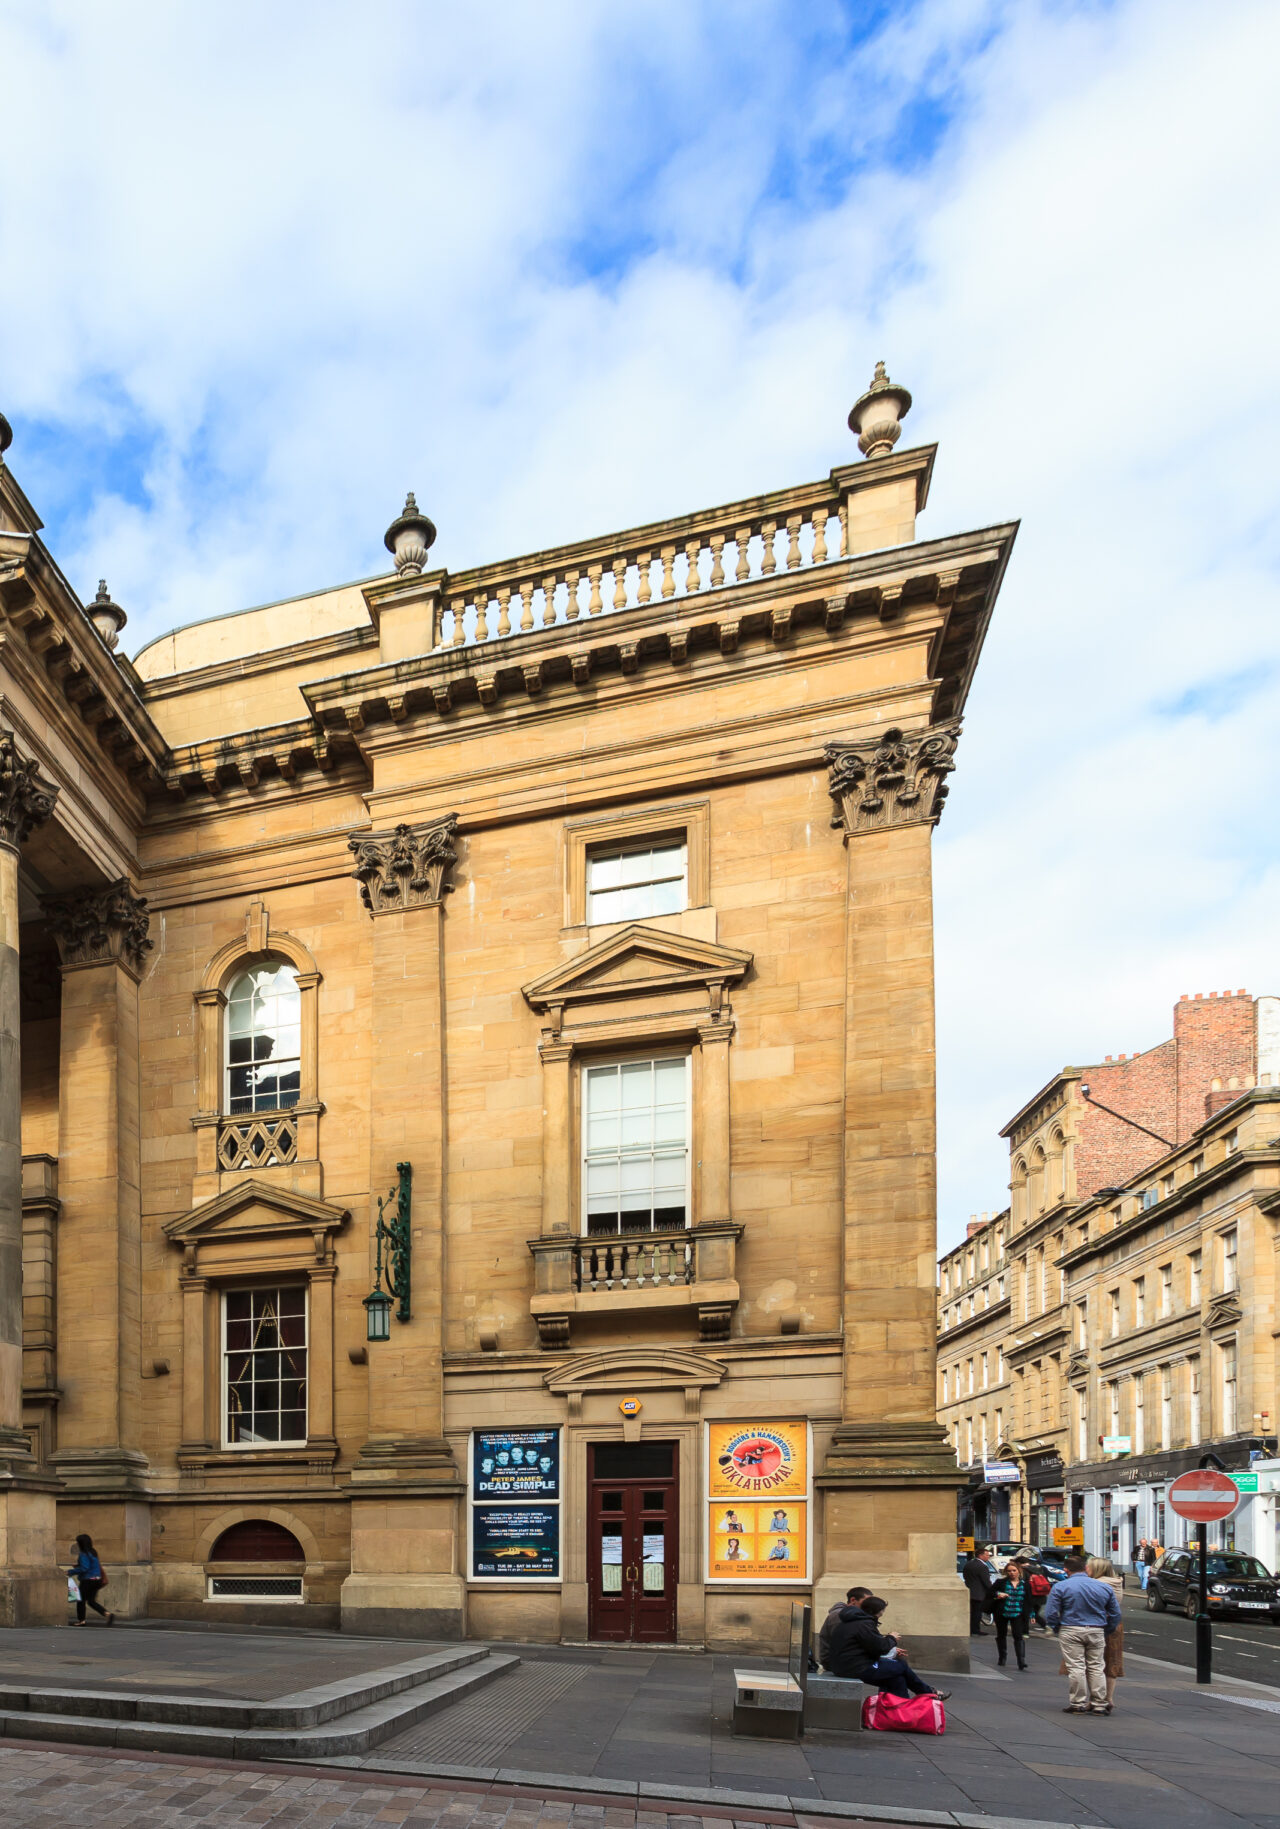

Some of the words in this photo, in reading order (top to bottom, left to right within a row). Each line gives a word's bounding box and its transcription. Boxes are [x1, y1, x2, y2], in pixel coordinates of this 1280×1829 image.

[726, 1434, 750, 1453] RODGERS
[480, 1482, 510, 1490] DEAD
[512, 1481, 556, 1489] SIMPLE
[721, 1465, 794, 1490] OKLAHOMA!
